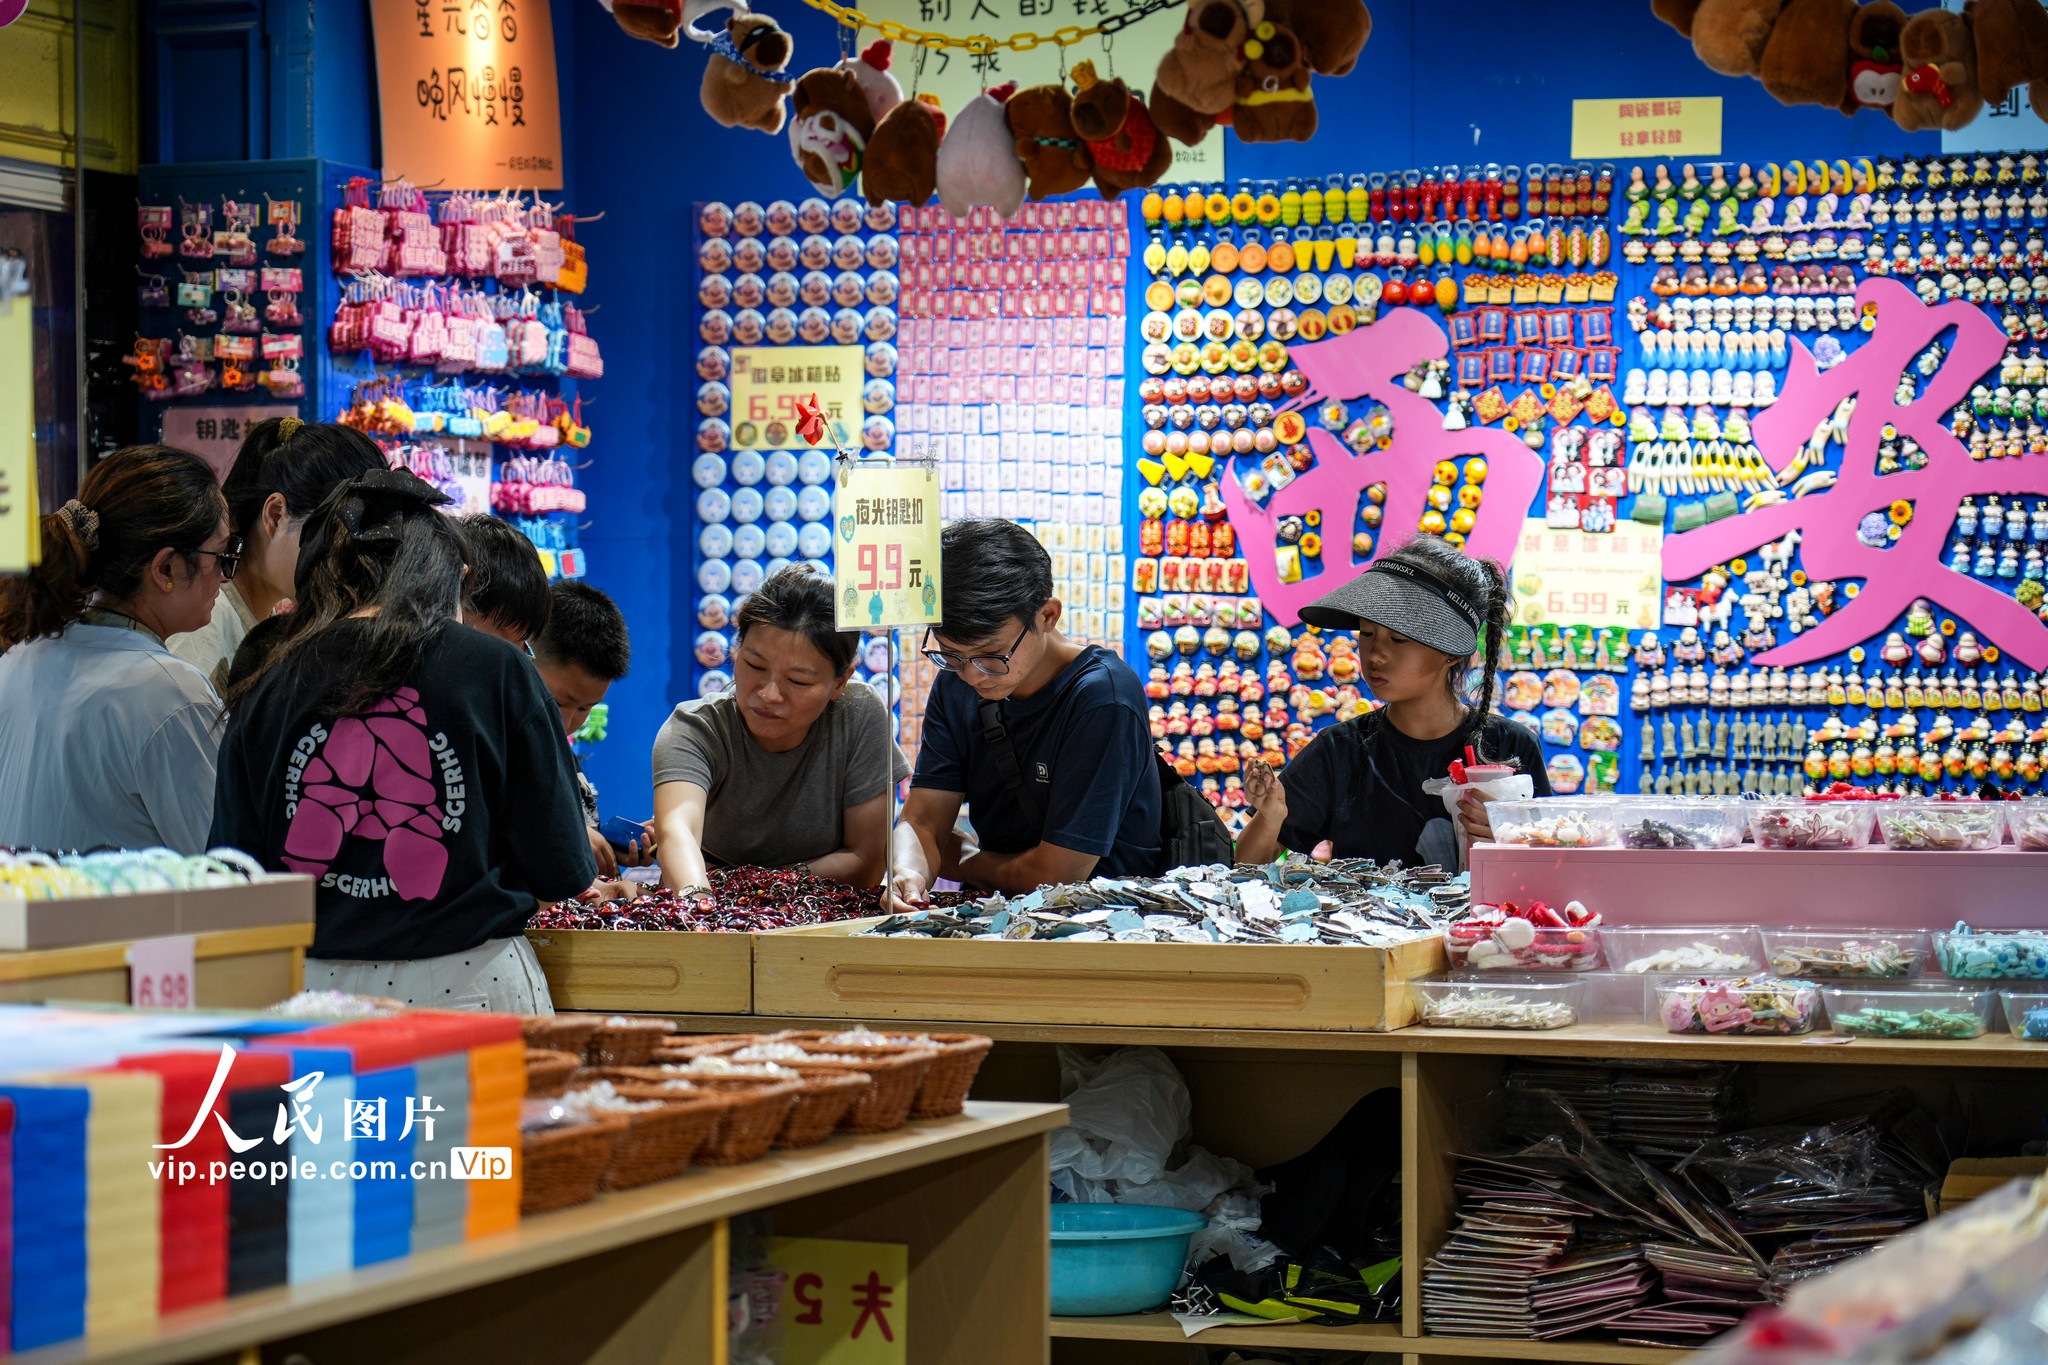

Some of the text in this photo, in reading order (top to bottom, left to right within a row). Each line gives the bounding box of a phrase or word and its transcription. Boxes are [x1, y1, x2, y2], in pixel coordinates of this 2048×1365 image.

[417, 66, 526, 126] 晚风慢慢
[829, 402, 843, 419] 元
[856, 498, 923, 525] 夜光钥匙扣
[858, 544, 922, 590] 9.9 元
[1548, 591, 1629, 614] 6.99 元
